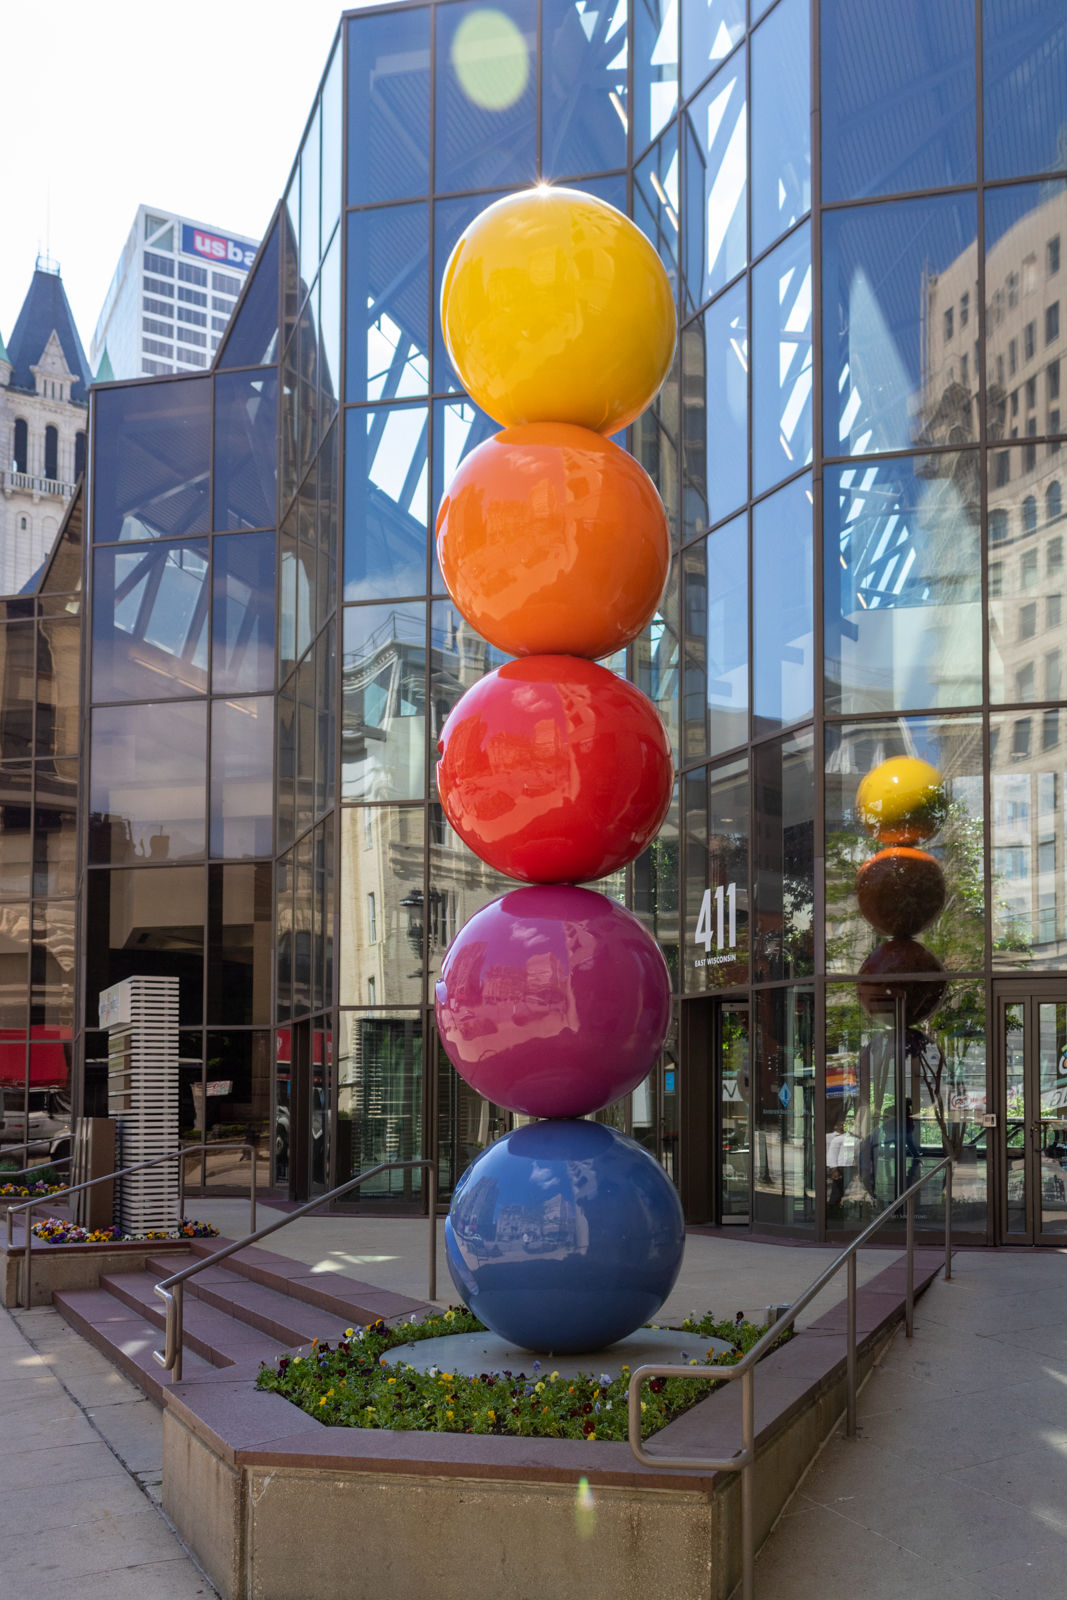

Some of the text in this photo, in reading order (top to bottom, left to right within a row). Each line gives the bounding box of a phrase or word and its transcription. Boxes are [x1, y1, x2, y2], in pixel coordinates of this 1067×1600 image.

[695, 882, 736, 952] 411
[694, 954, 737, 967] EAST WISCONSIN
